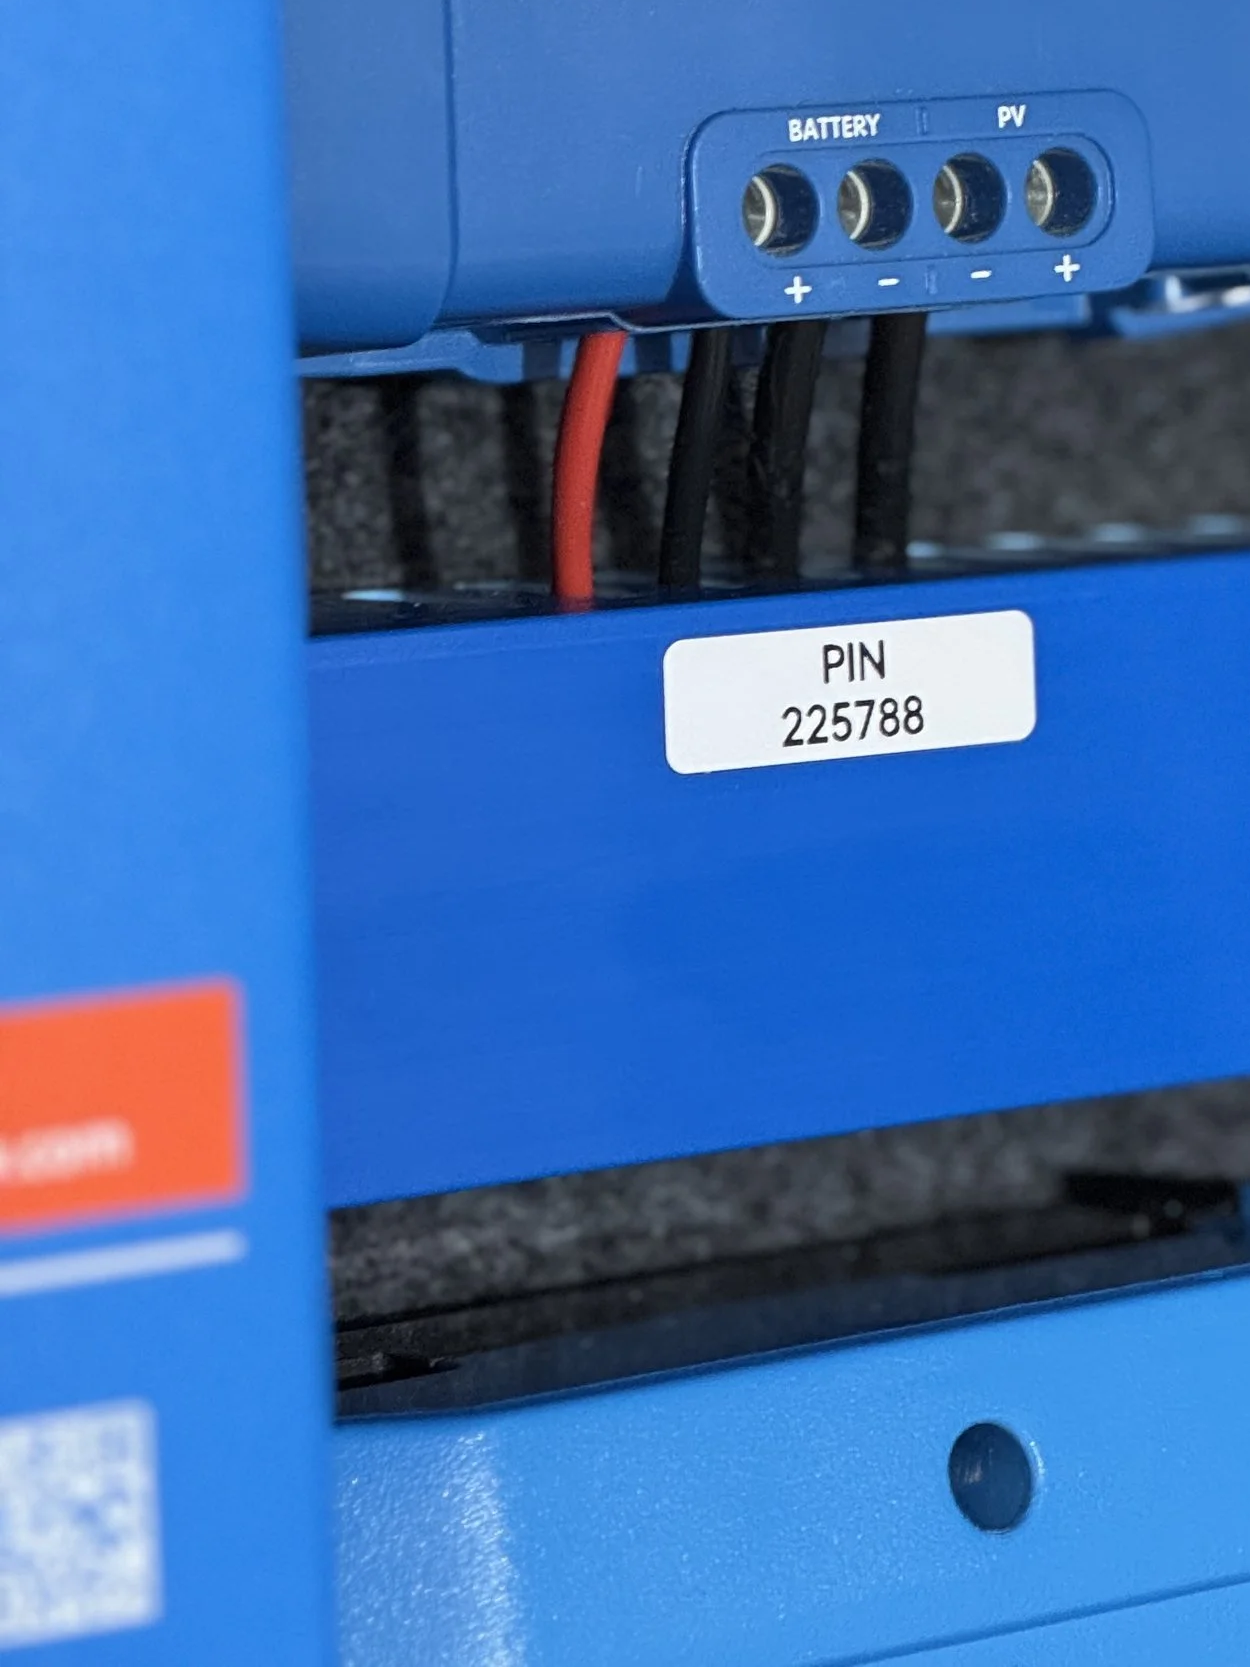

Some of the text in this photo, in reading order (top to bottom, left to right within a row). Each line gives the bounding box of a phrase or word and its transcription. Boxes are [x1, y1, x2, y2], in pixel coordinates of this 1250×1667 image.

[787, 113, 882, 143] BATTERY
[996, 104, 1027, 129] PV
[822, 639, 887, 685] PIN
[781, 694, 925, 749] 225788
